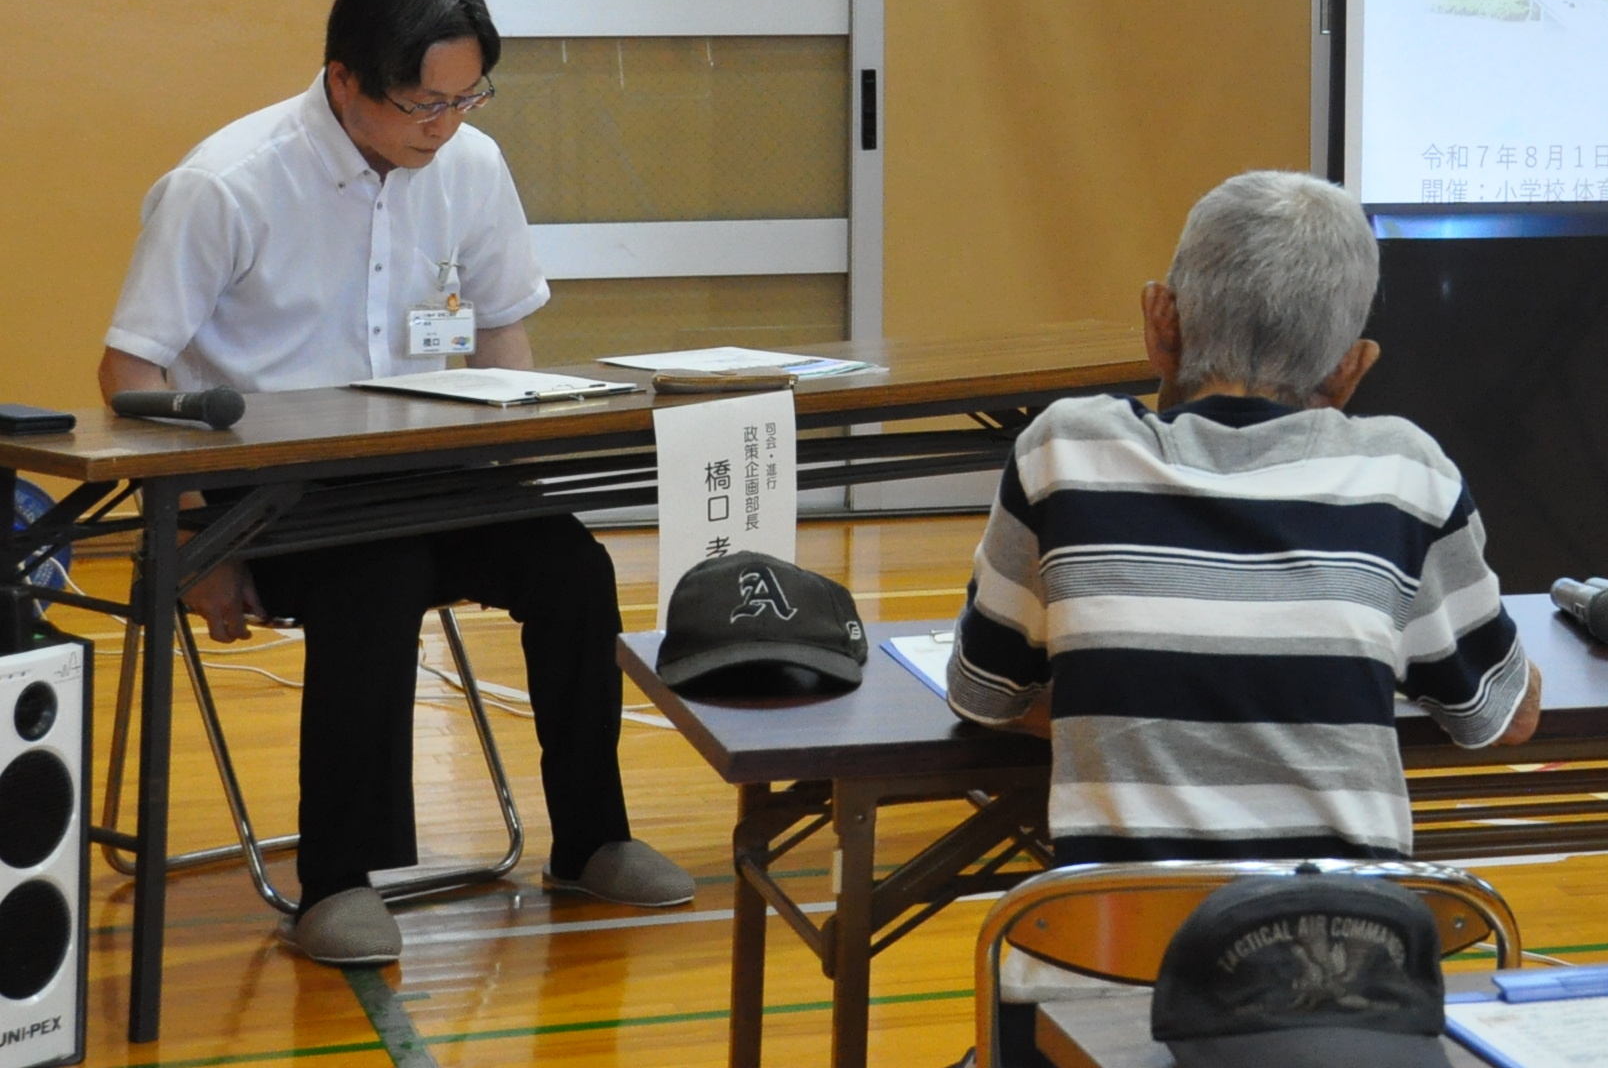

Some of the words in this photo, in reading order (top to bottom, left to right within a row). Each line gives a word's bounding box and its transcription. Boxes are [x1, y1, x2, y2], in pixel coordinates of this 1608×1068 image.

[743, 425, 760, 532] 政策企画部長
[765, 422, 777, 490] 司会・進行
[704, 458, 732, 523] 橋口
[1217, 918, 1293, 974] TACTICAL
[1297, 914, 1328, 937] AIR
